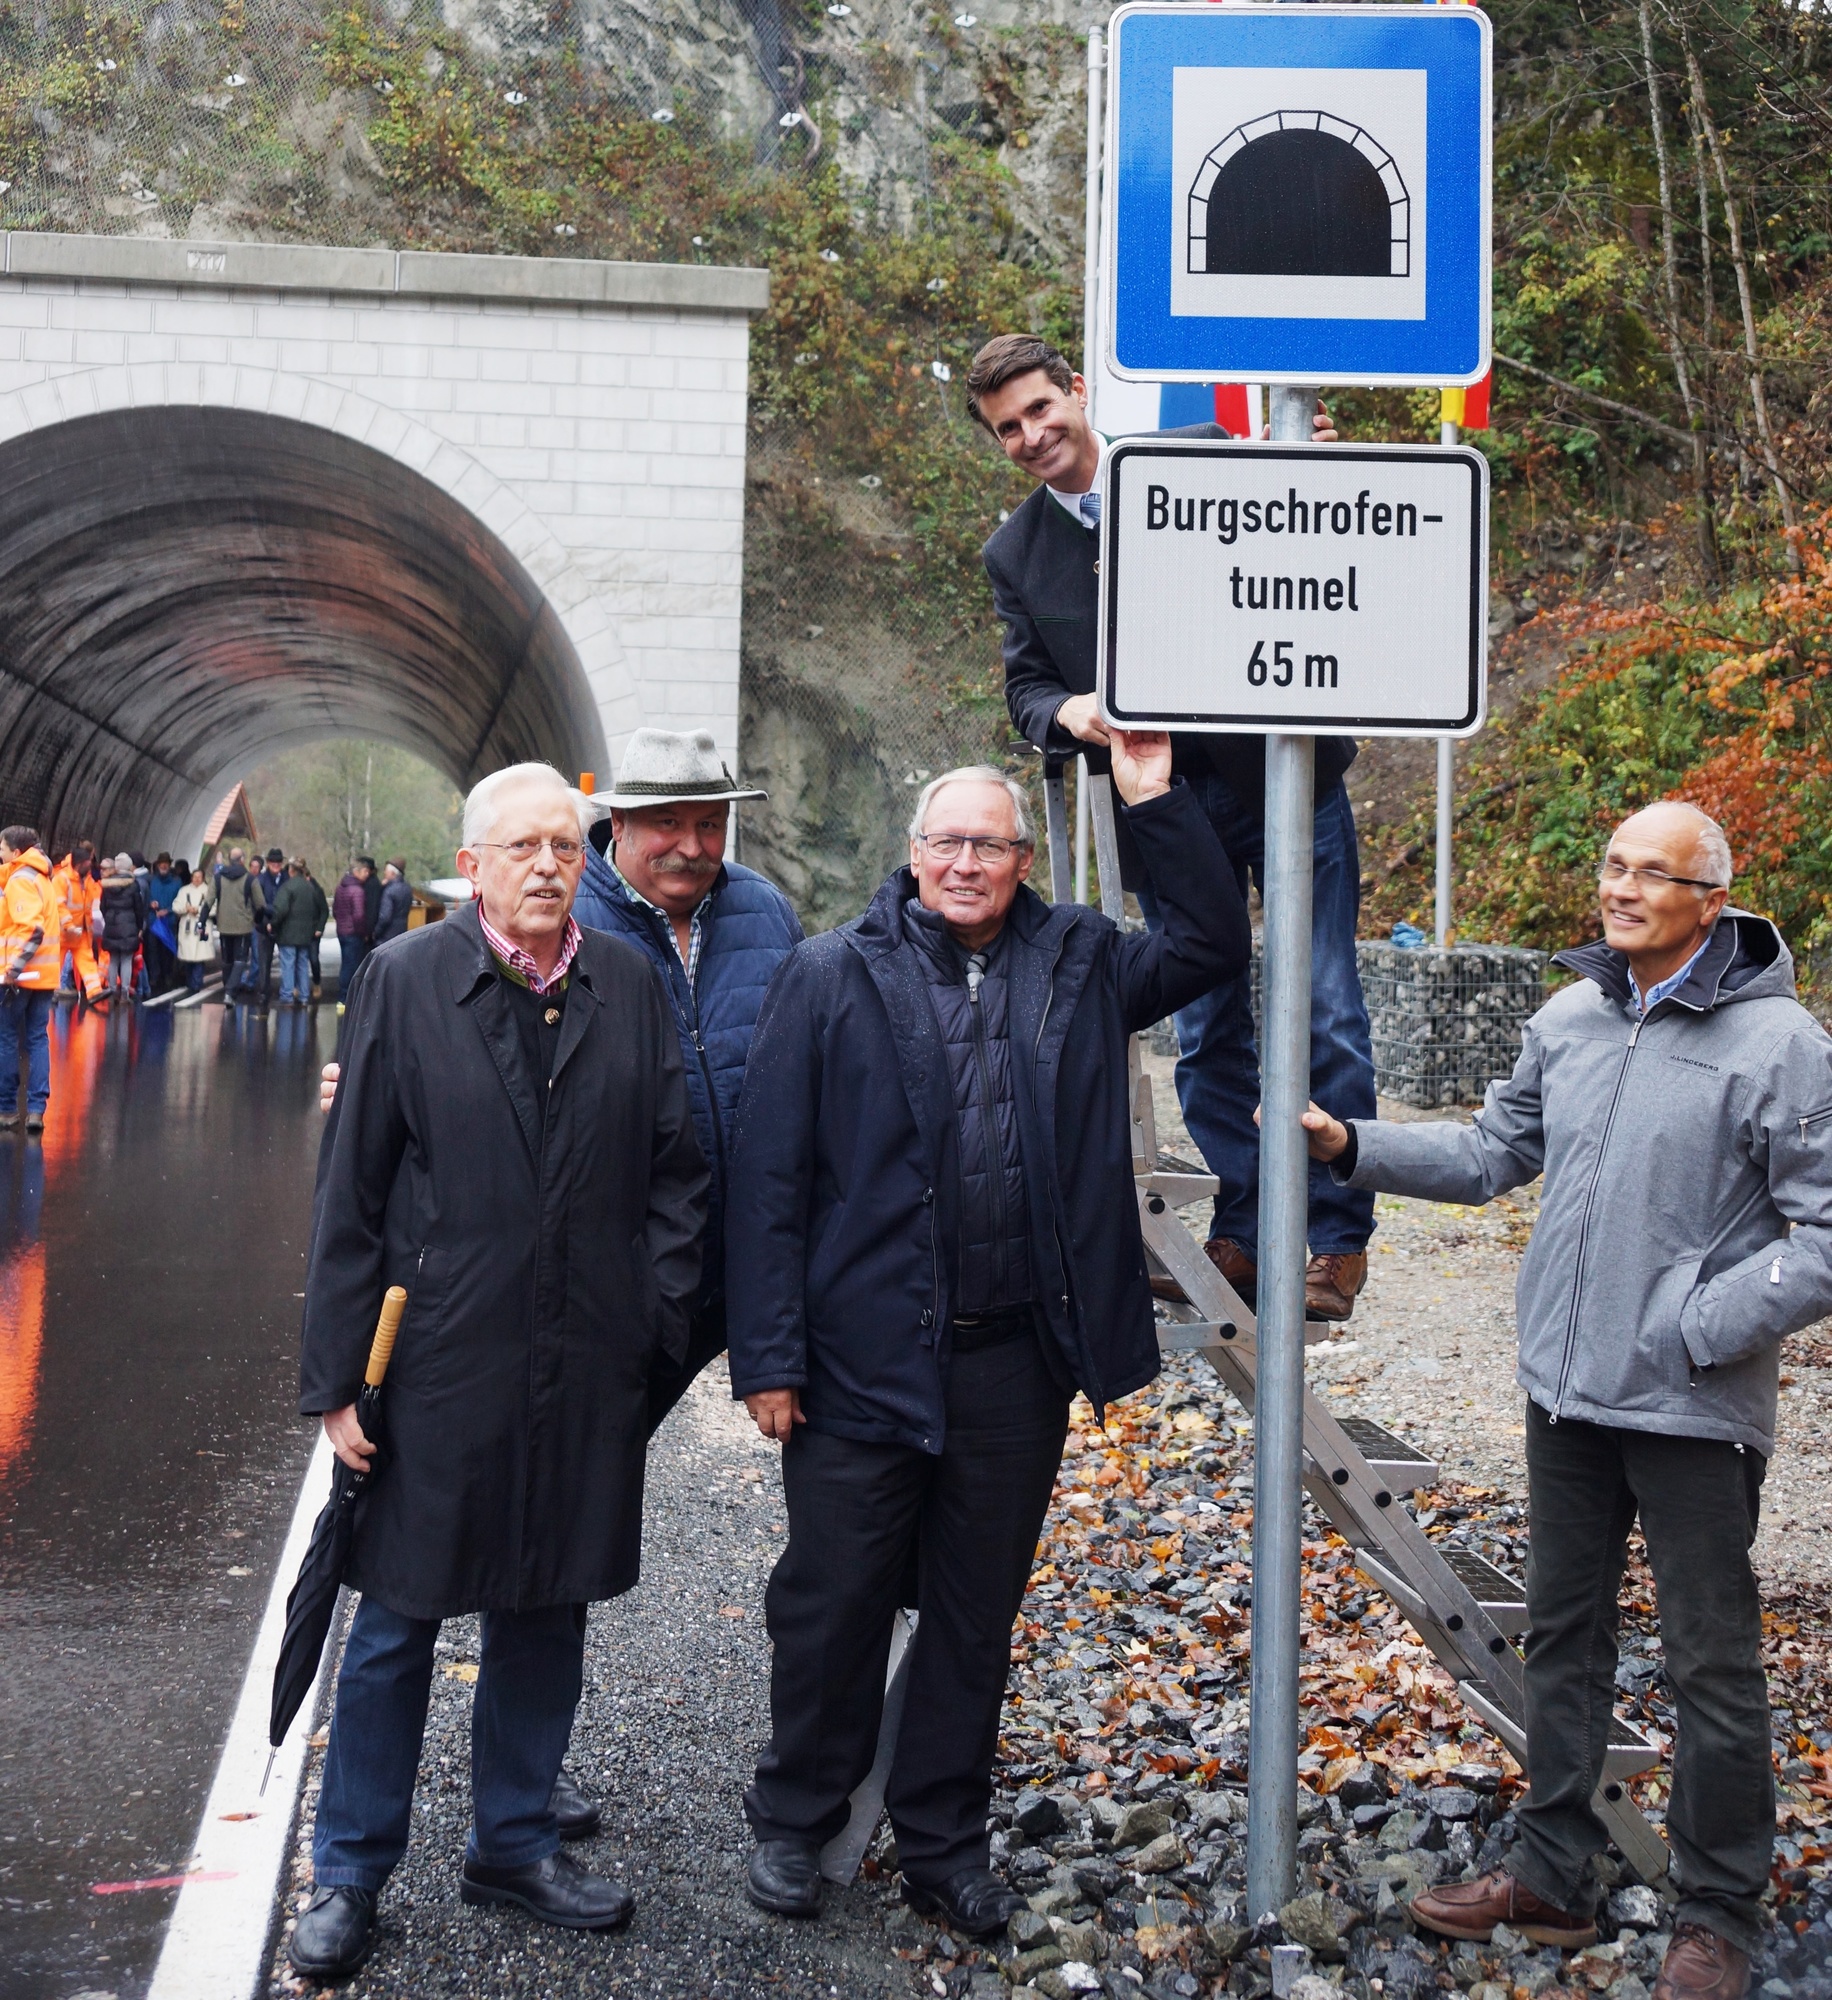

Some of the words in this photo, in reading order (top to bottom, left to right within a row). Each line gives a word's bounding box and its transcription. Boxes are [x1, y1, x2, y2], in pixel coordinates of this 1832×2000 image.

[1147, 484, 1443, 545] Burgschrofen-
[1229, 566, 1359, 612] tunnel
[1247, 640, 1294, 687] 65
[1304, 654, 1338, 688] m
[1670, 1054, 1719, 1072] J.LINDEBERG
